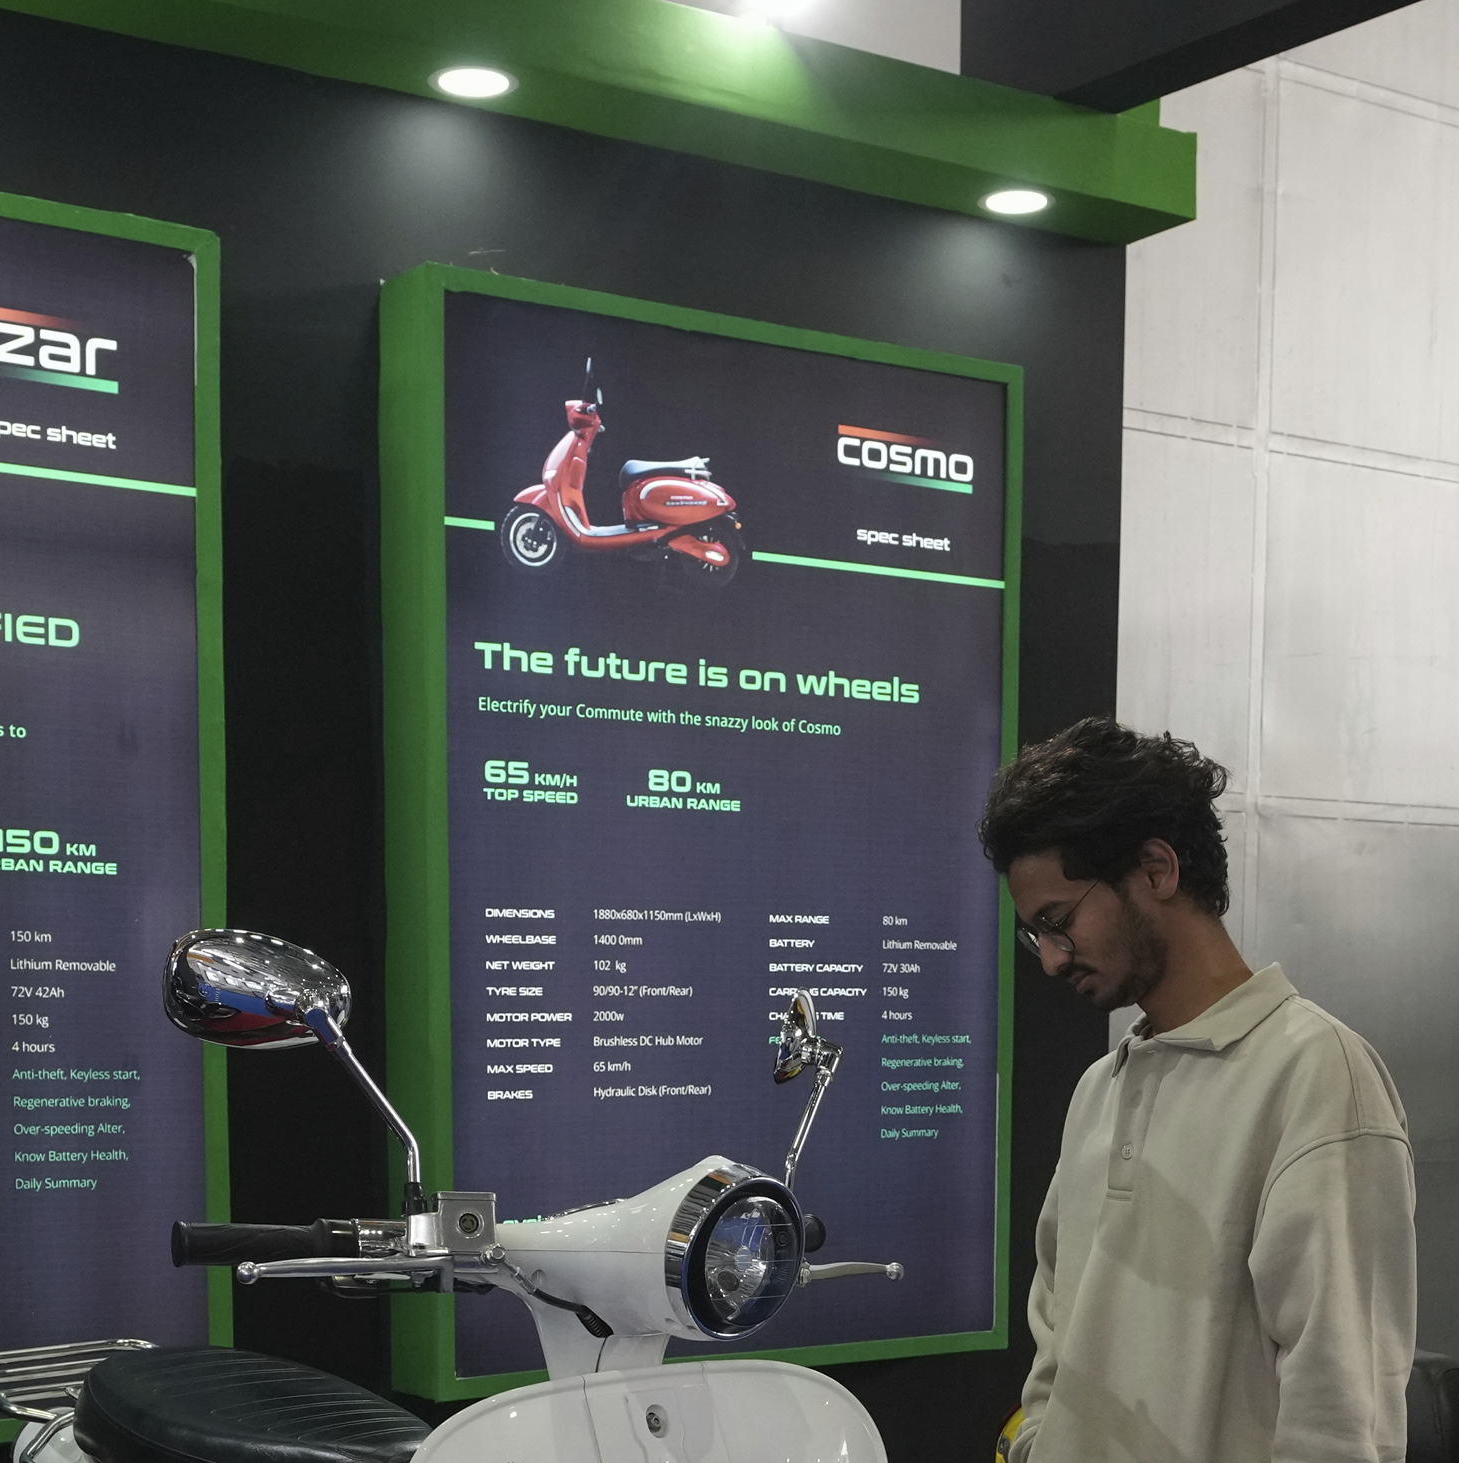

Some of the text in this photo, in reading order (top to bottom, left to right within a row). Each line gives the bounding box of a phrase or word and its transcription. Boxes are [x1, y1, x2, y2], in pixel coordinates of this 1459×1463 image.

[46, 425, 117, 450] sheet
[856, 528, 951, 552] spec sheet
[474, 641, 920, 704] The future is on wheels
[478, 696, 842, 736] Electrify your Commute with the snazzy look of Cosmo
[8, 724, 27, 739] to
[484, 761, 578, 788] 65 KM/H
[648, 769, 720, 795] 80 KM
[482, 787, 579, 805] TOP SPEED
[626, 794, 741, 812] URBAN RANGE
[66, 843, 97, 857] KM
[48, 859, 118, 876] RANGE
[485, 908, 556, 919] DIMENSIONS
[592, 908, 722, 924] 1880x680x1150mm (LxWxH)
[769, 914, 830, 925] MAX RANGE
[882, 915, 908, 926] 80 km
[485, 934, 557, 945] WHEELBASE
[593, 934, 617, 946] 1400
[768, 938, 816, 948] BATTERY
[485, 960, 556, 971] NET WEIGHT
[593, 959, 627, 974] 102 kg
[768, 963, 864, 973] BATTERY CAPACITY
[882, 962, 921, 974] 72V 30Ah
[10, 985, 65, 998] 72V 42Ah
[485, 986, 544, 997] TYRE SIZE
[639, 985, 693, 998] (Front/Rear)
[820, 988, 867, 997] CAPACITY
[486, 1012, 573, 1022] MOTOR POWER
[593, 1010, 625, 1022] 2000w
[820, 1012, 845, 1021] TIME
[486, 1037, 561, 1048] MOTOR TYPE
[593, 1035, 704, 1047] Brushless DC Hub Motor
[486, 1063, 554, 1074] MAX SPEED
[593, 1060, 632, 1073] 65 km/h
[12, 1067, 141, 1083] Anti-theft, Keyless start,
[487, 1089, 534, 1101] BRAKES
[593, 1084, 712, 1100] Hydraulic Disk (Front/Rear)
[13, 1095, 131, 1111] Regenerative braking,
[13, 1122, 126, 1137] Over-speeding Alter,
[14, 1149, 129, 1164] Know Battery Health,
[15, 1177, 98, 1192] Daily Summary
